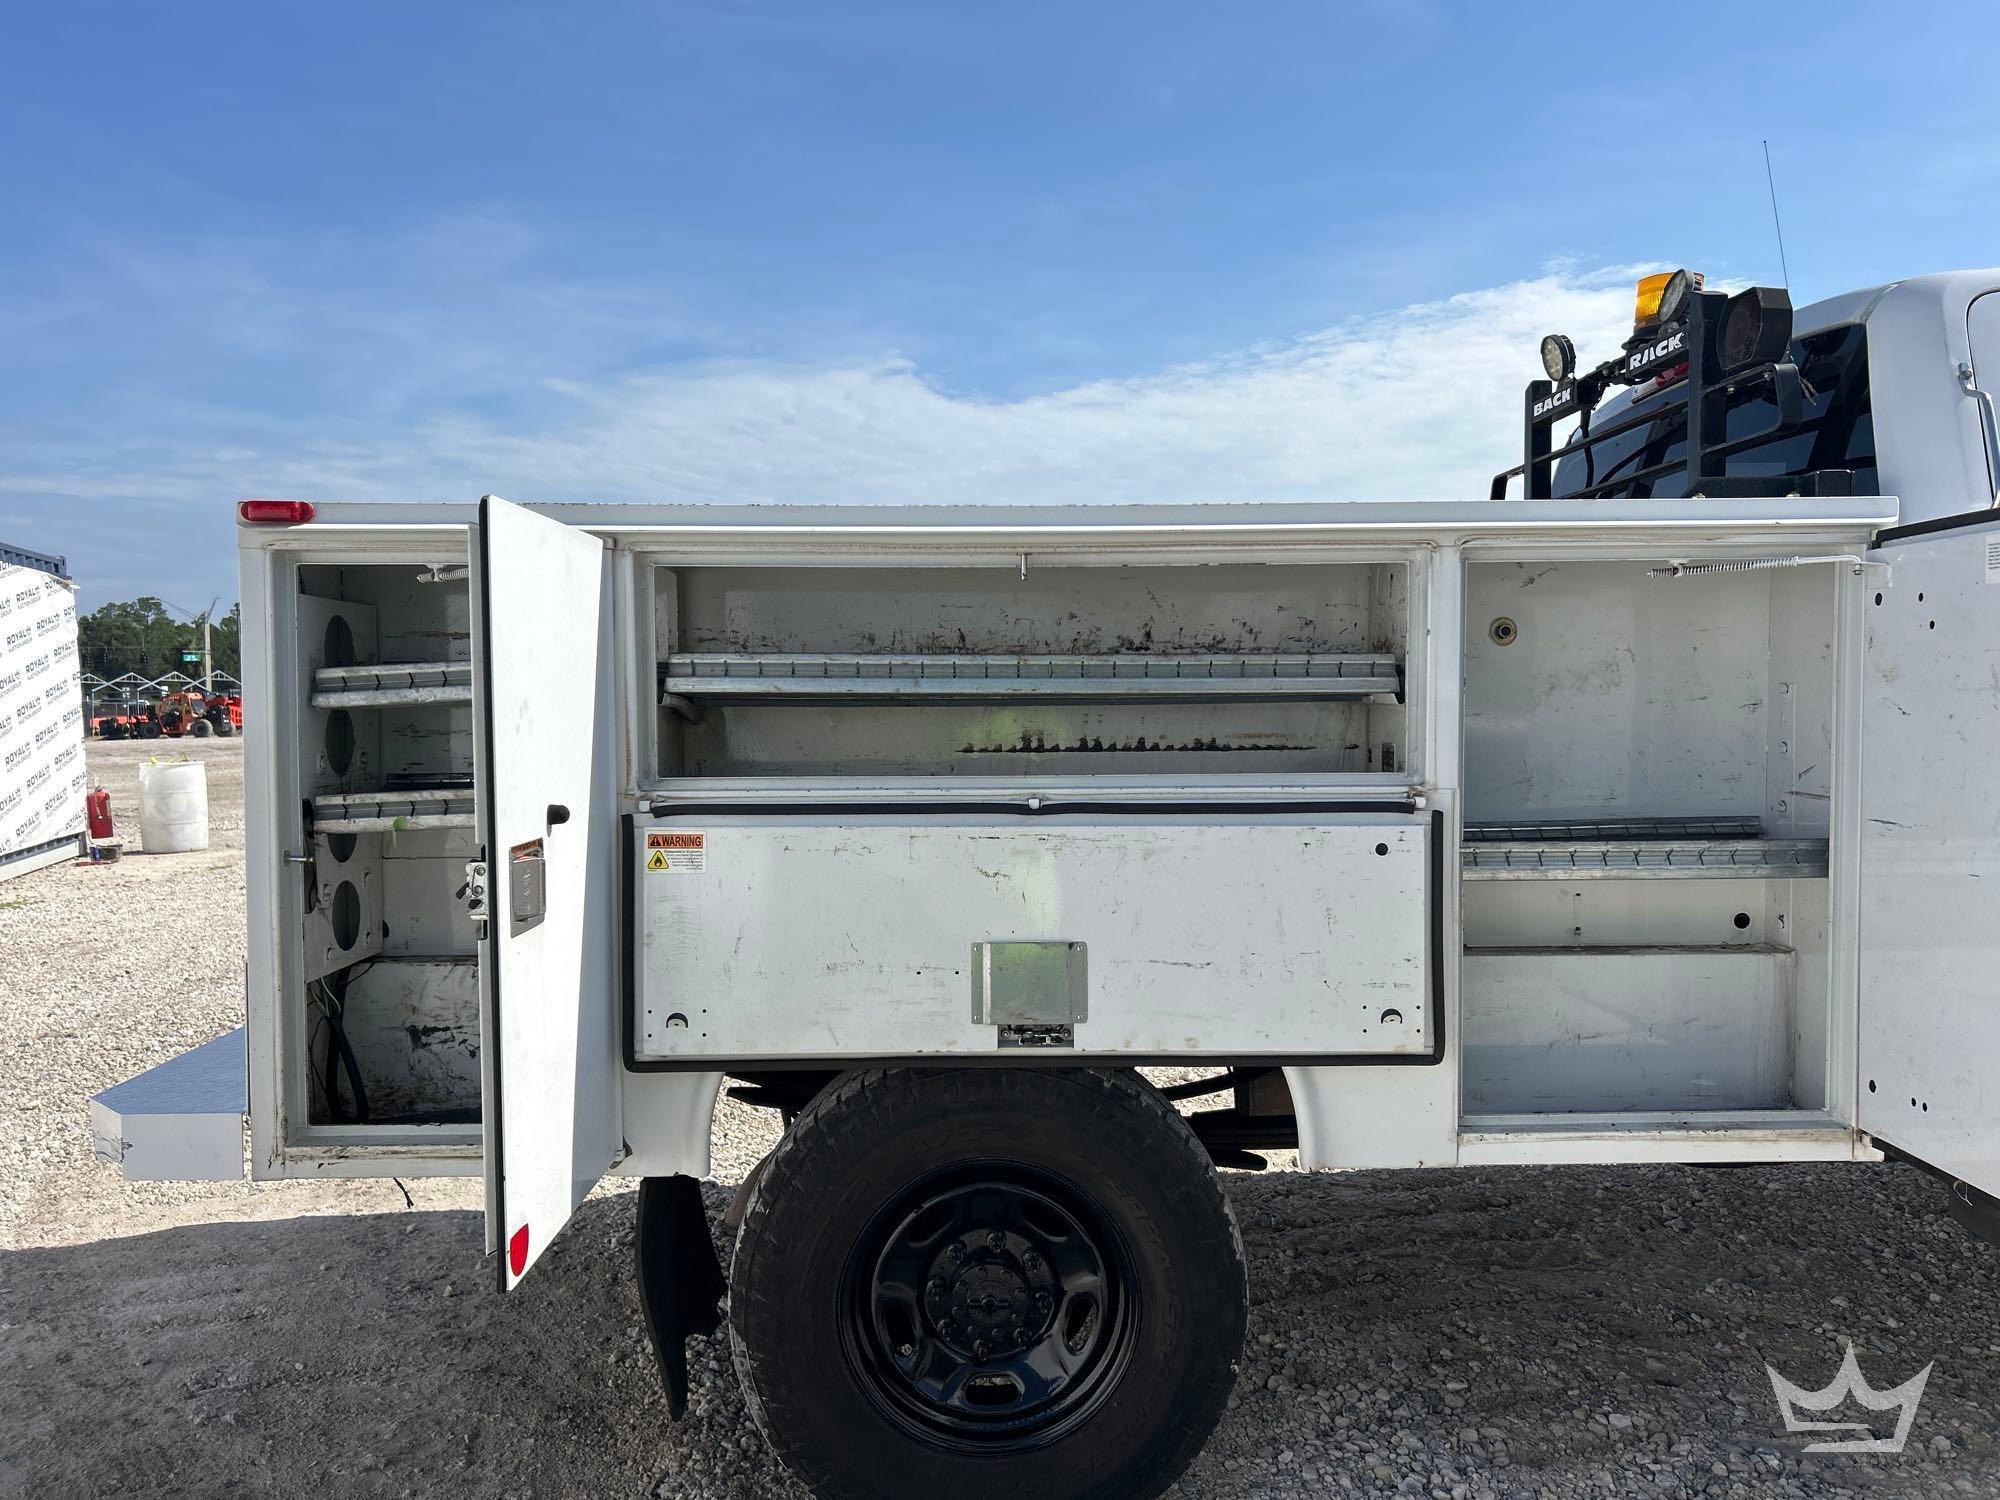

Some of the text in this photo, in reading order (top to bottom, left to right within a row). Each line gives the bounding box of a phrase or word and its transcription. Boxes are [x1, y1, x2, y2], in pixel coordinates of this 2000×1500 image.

[1534, 331, 1684, 417] BACK RACK
[16, 588, 35, 602] ROYAL
[37, 616, 55, 630] ROYAL
[7, 630, 26, 645] ROYAL
[54, 641, 72, 656] ROYAL
[26, 657, 44, 673] ROYAL
[46, 682, 63, 697] ROYAL
[17, 700, 36, 718] ROYAL
[35, 725, 54, 743] ROYAL
[5, 745, 25, 766] ROYAL
[55, 746, 73, 765] ROYAL
[27, 768, 46, 788] ROYAL
[16, 816, 35, 838] ROYAL
[661, 836, 702, 847] WARNING
